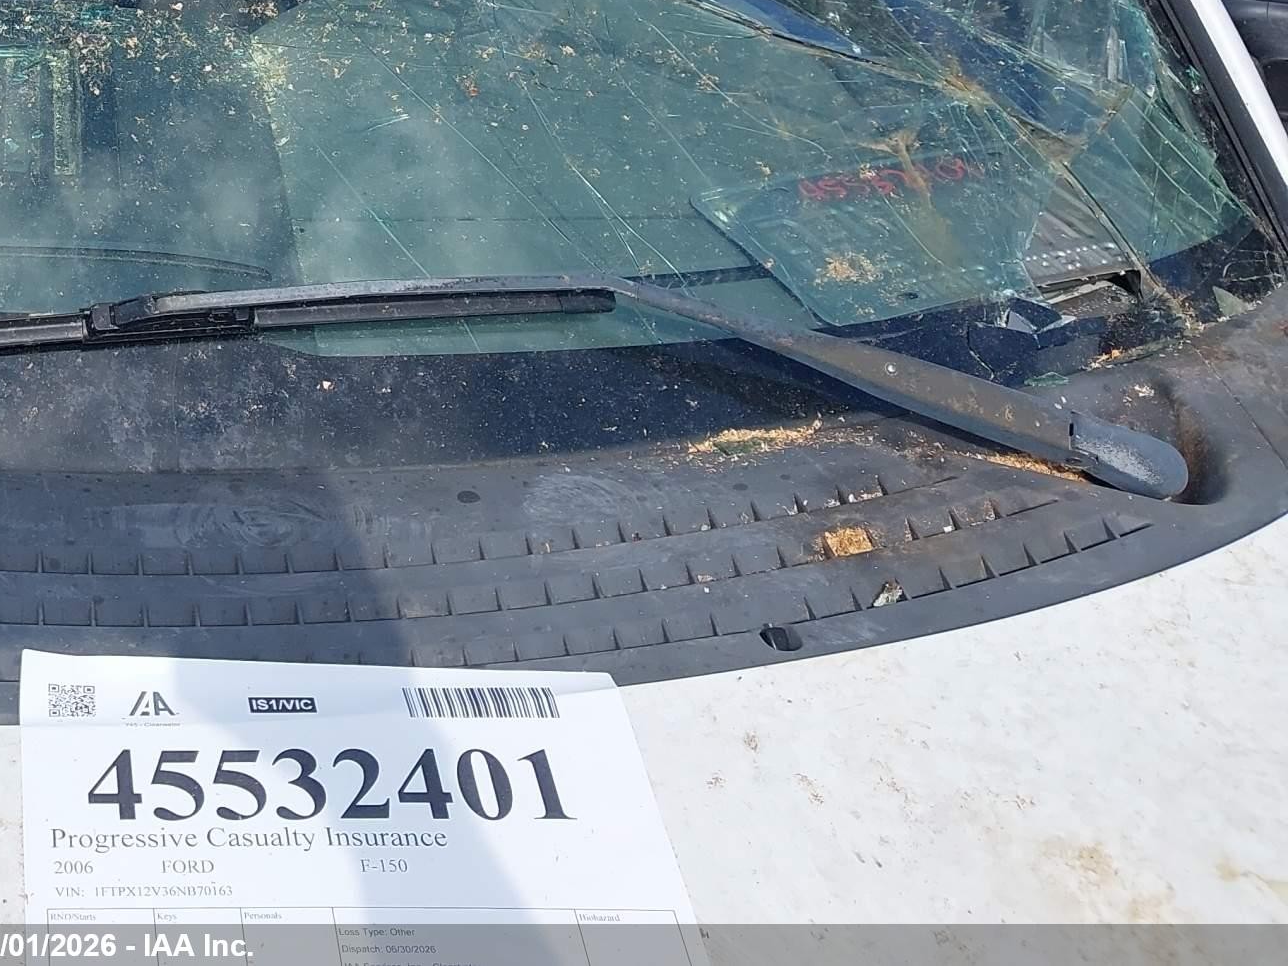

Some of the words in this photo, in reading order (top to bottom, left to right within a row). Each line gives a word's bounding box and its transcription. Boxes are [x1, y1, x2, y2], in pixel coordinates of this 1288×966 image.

[251, 699, 314, 712] IS1/VIC
[87, 748, 577, 821] 45532401
[50, 827, 198, 854] Progressive
[206, 827, 315, 852] Casualty
[325, 827, 448, 848] Insurance
[53, 860, 94, 875] 2006
[161, 859, 215, 875] FORD
[360, 858, 408, 874] F-150
[55, 886, 85, 898] VIN:
[94, 885, 233, 898] 1FTPX12V36NB70163
[156, 912, 177, 922] Keys
[243, 911, 283, 921] Personals
[338, 927, 360, 936] Loss
[363, 927, 387, 938] Type:
[389, 927, 416, 937] Other
[341, 944, 383, 955] Dispatch:
[385, 944, 437, 954] 06/30/2026
